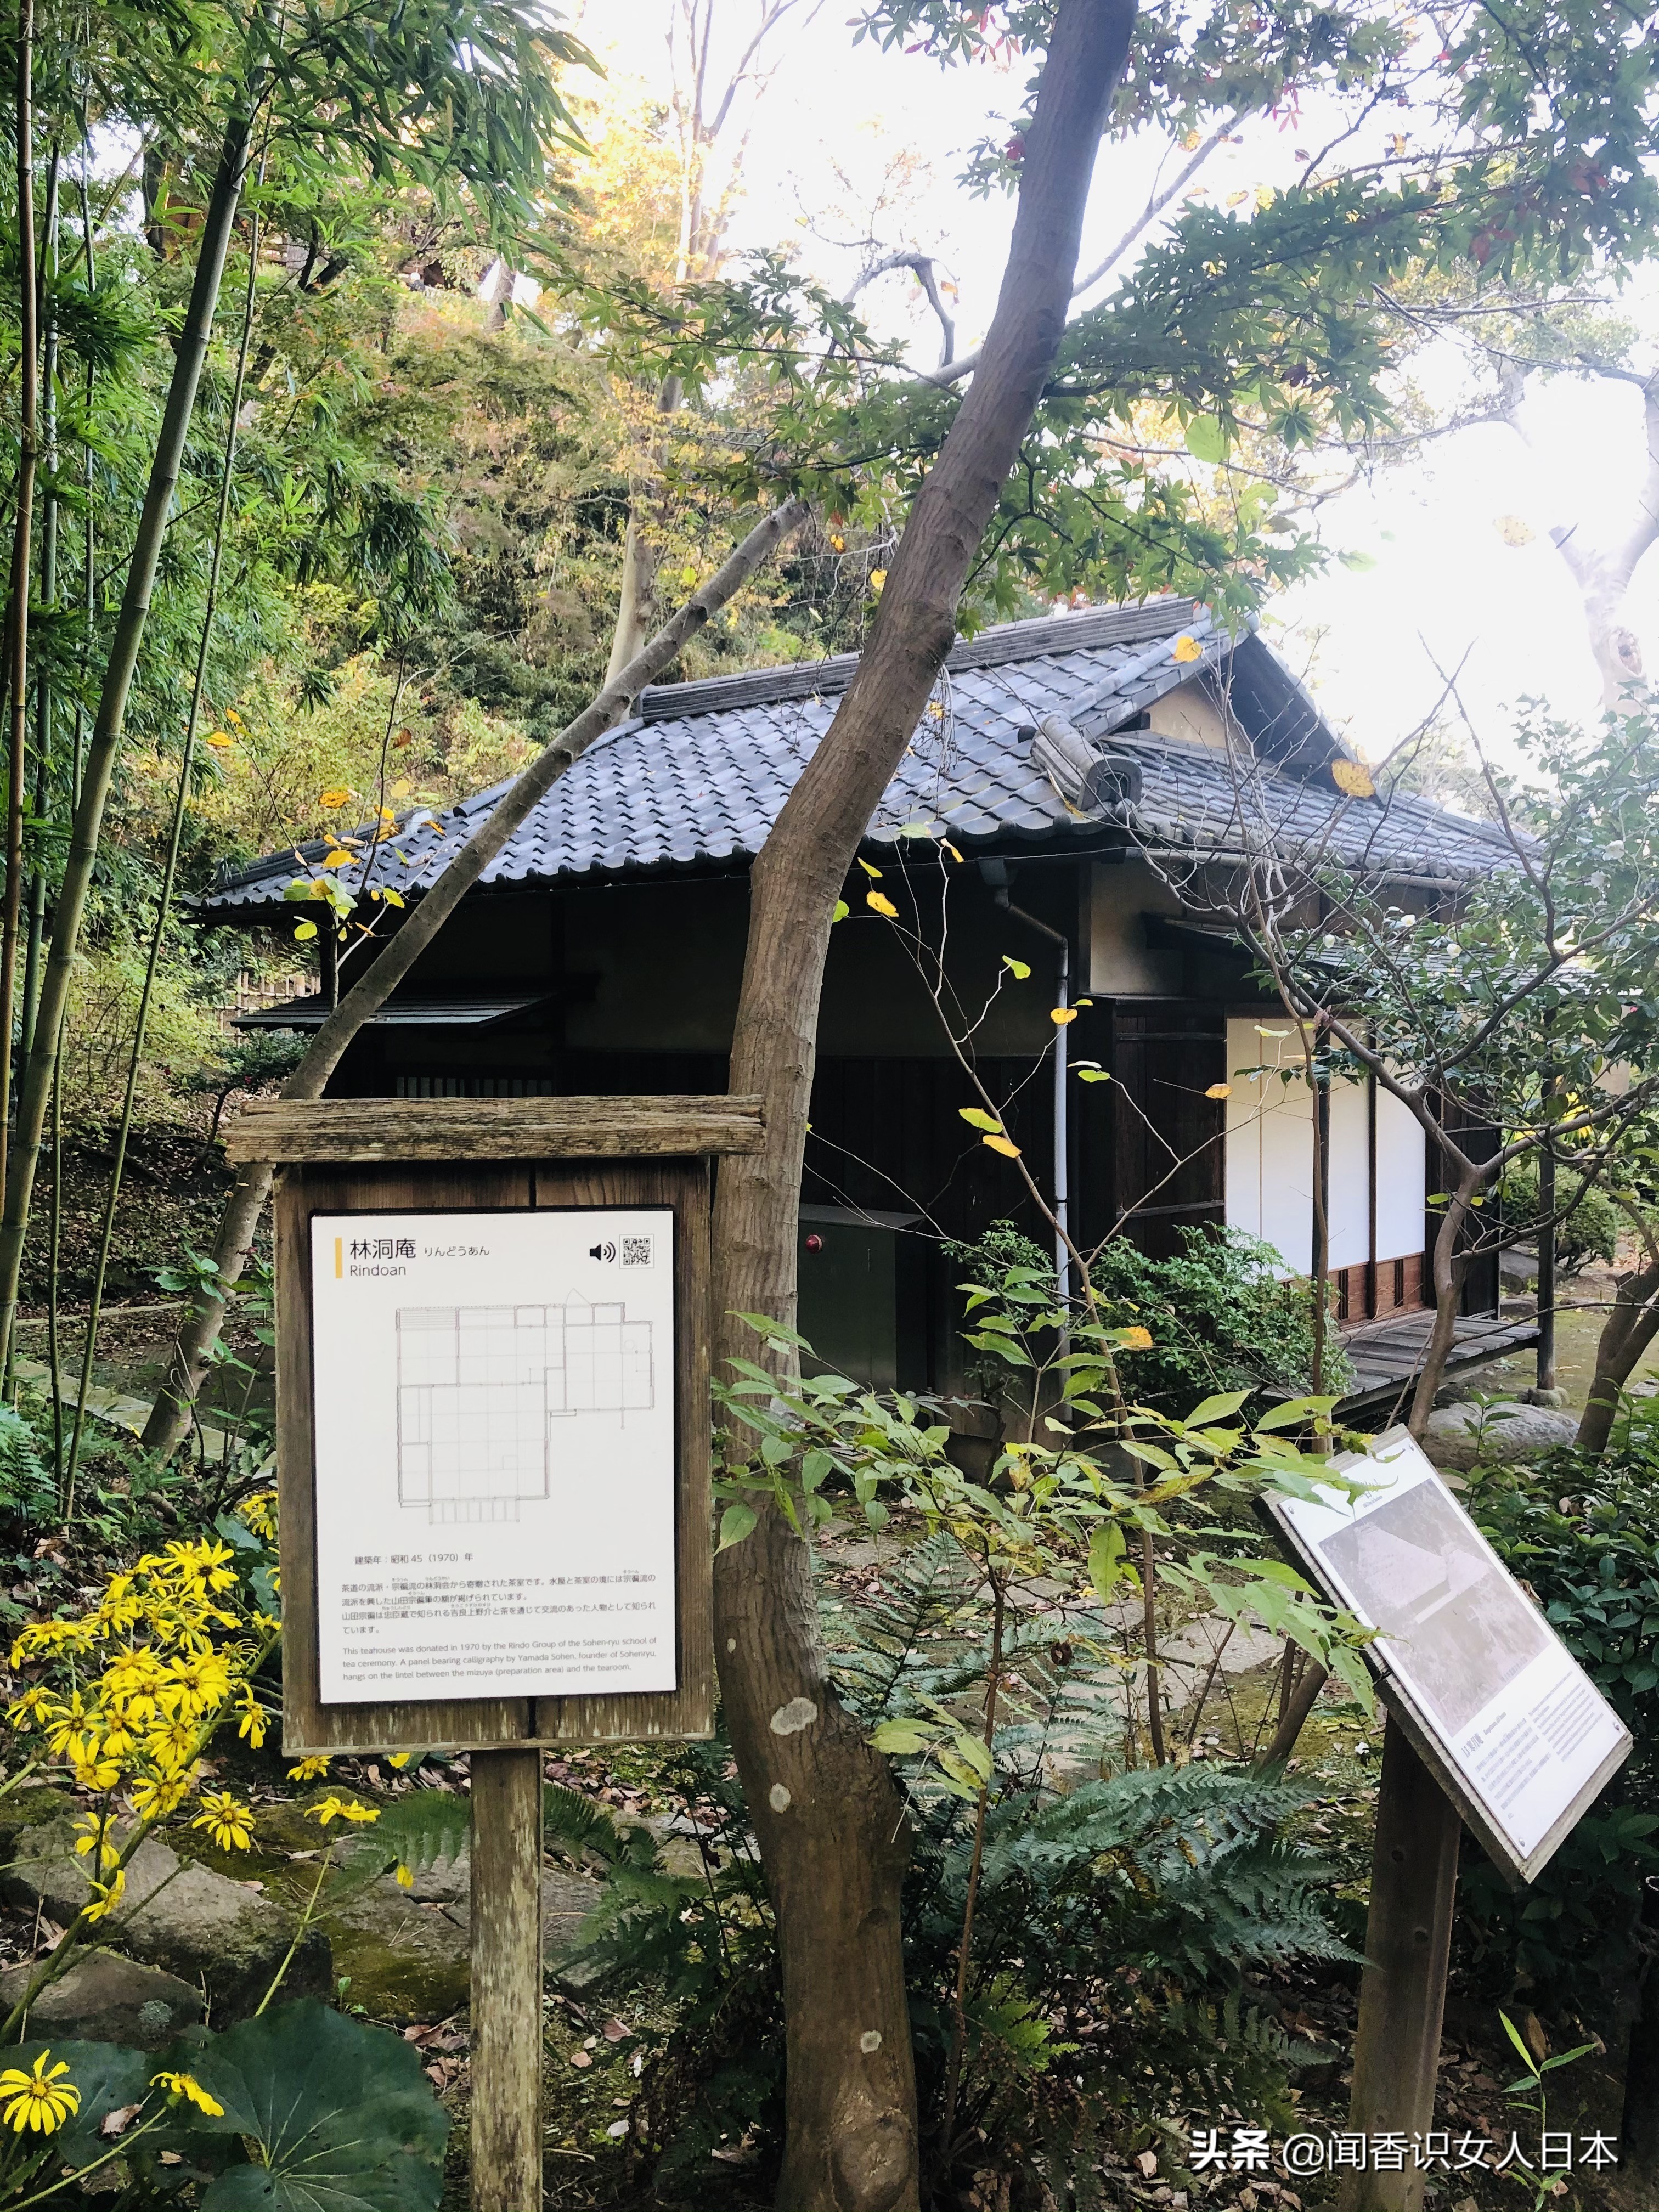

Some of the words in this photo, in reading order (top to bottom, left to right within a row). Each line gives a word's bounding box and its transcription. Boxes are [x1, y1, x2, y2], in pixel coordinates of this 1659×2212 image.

[349, 1238, 416, 1260] 林洞庵
[425, 1246, 490, 1257] りんどうあん
[350, 1265, 407, 1277] Rindoan
[343, 1625, 379, 1634] ています。
[482, 1643, 491, 1652] by
[622, 1637, 647, 1645] school
[408, 1658, 430, 1667] panel
[432, 1657, 461, 1666] bearing
[463, 1656, 504, 1664] calligraphy
[506, 1655, 515, 1663] by
[495, 1667, 542, 1676] (preparation
